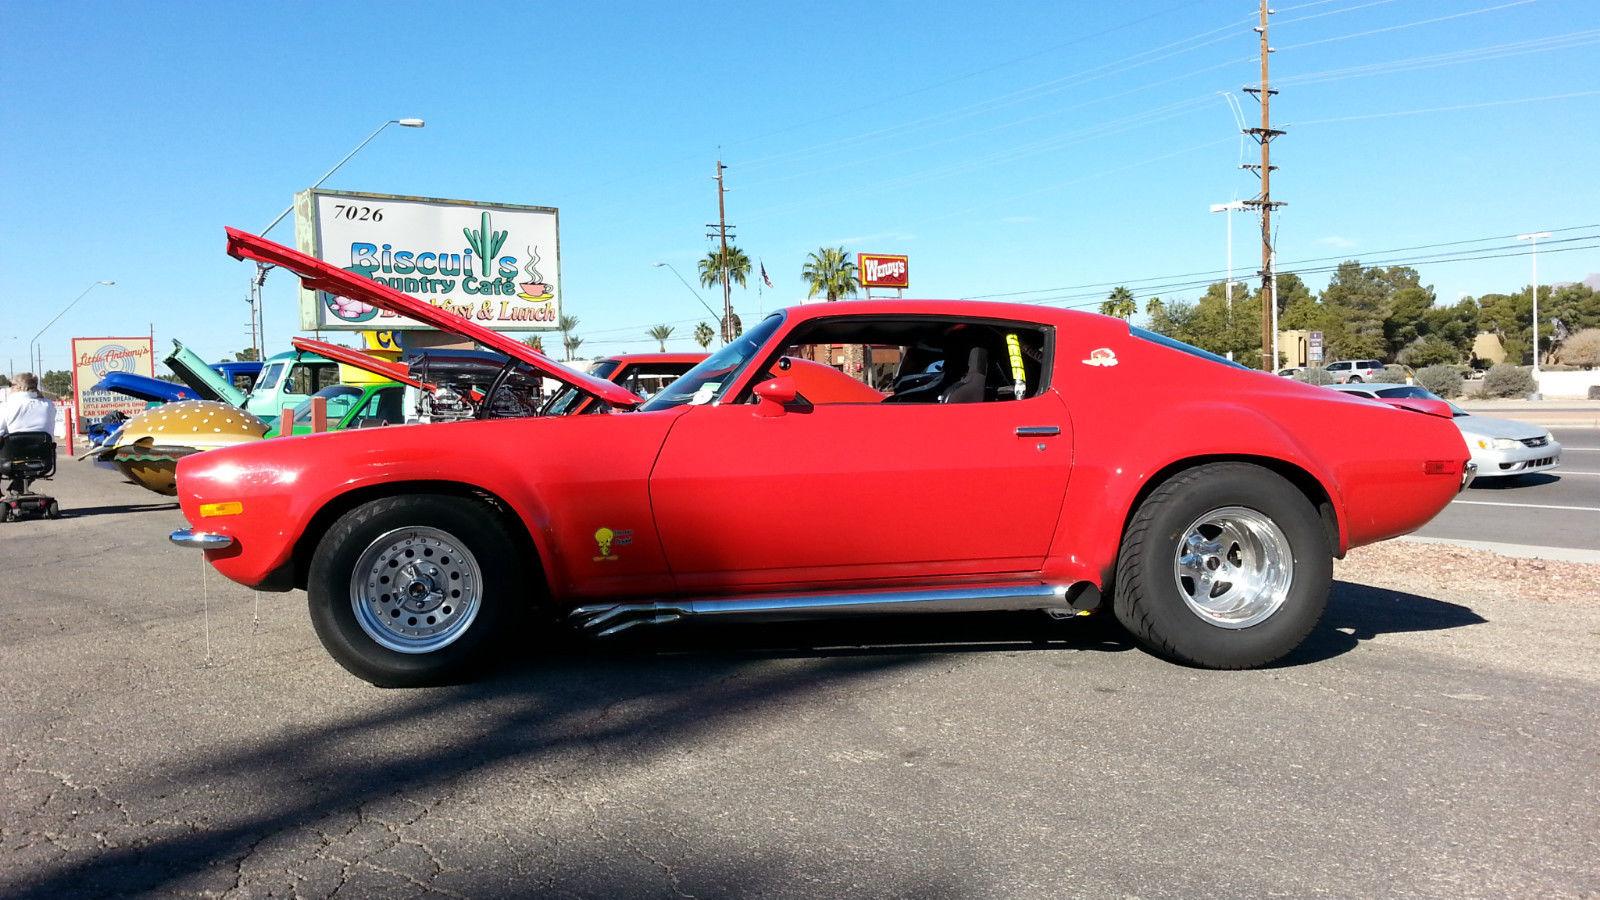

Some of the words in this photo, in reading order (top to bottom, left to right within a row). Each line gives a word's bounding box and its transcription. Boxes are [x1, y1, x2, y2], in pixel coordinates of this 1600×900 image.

[334, 205, 384, 222] 7026
[373, 276, 455, 294] ountry
[477, 301, 497, 321] &
[498, 301, 555, 321] Lunch
